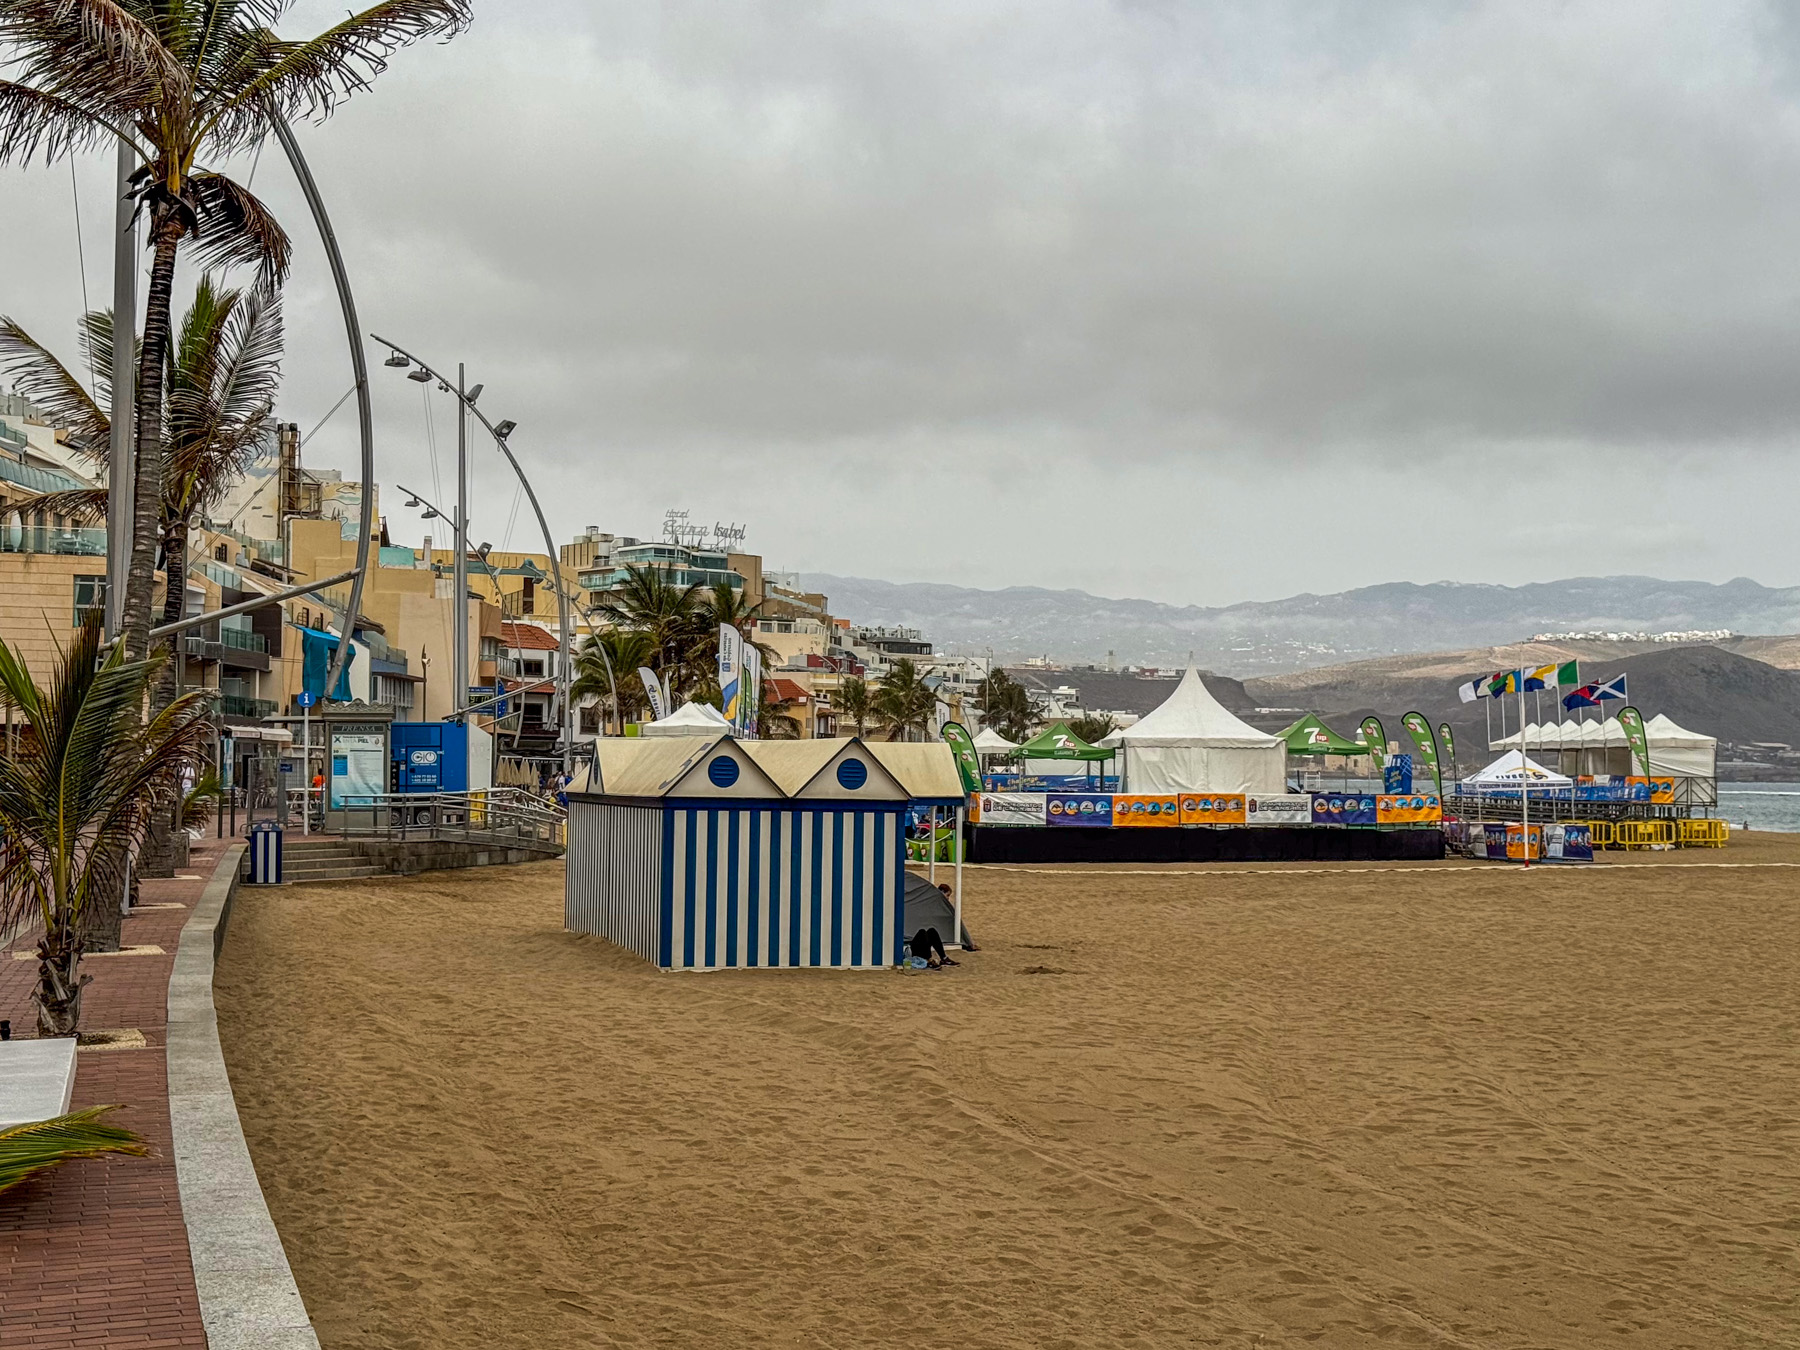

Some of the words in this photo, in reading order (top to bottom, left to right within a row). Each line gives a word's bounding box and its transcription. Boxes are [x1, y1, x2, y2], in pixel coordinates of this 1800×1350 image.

[665, 508, 690, 518] Hotel
[662, 519, 710, 537] Reina
[713, 521, 747, 540] Isabel
